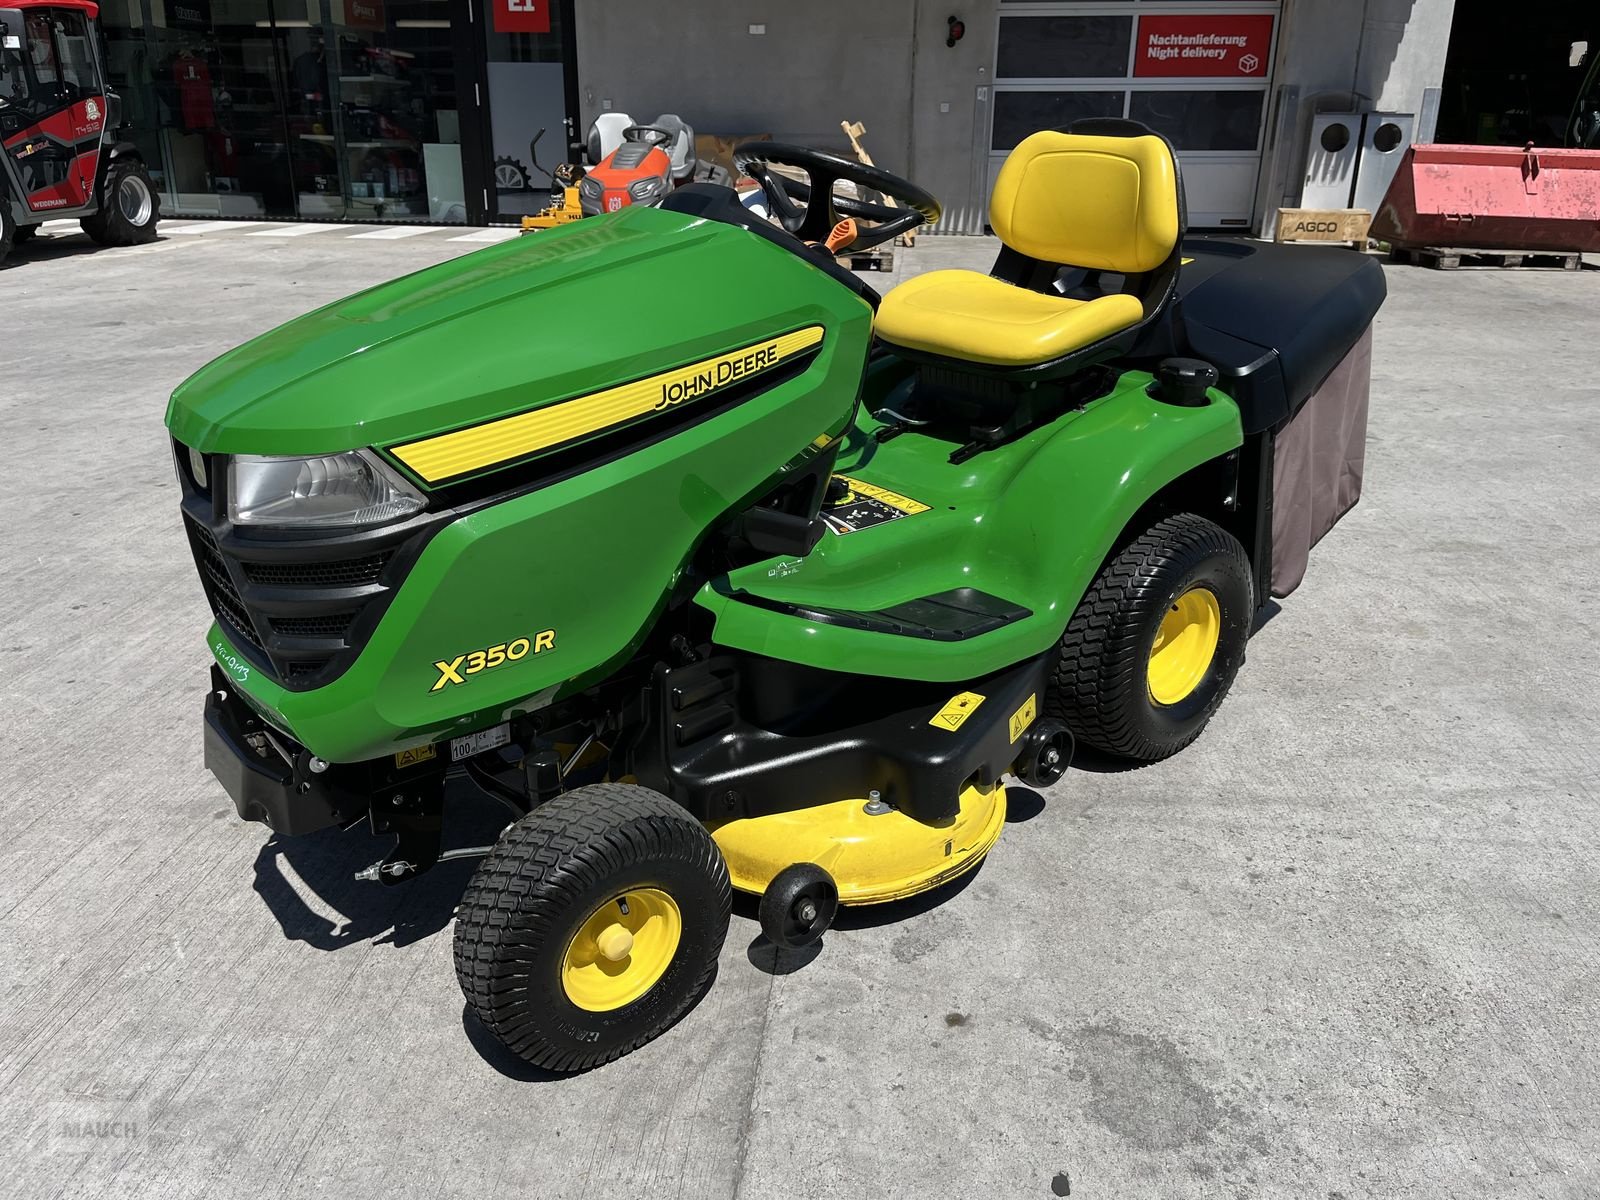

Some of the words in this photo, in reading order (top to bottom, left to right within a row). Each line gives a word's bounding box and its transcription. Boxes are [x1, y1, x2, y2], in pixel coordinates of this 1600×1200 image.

[1149, 34, 1247, 47] Nachtanlieferung
[1148, 47, 1179, 60] Night
[1181, 47, 1227, 60] delivery
[33, 198, 67, 208] WEIDEMANN
[1295, 222, 1338, 233] AGCO
[655, 370, 712, 408] JOHN
[717, 344, 778, 383] DEERE
[428, 637, 531, 692] X350
[534, 629, 556, 654] R
[453, 742, 471, 758] 100
